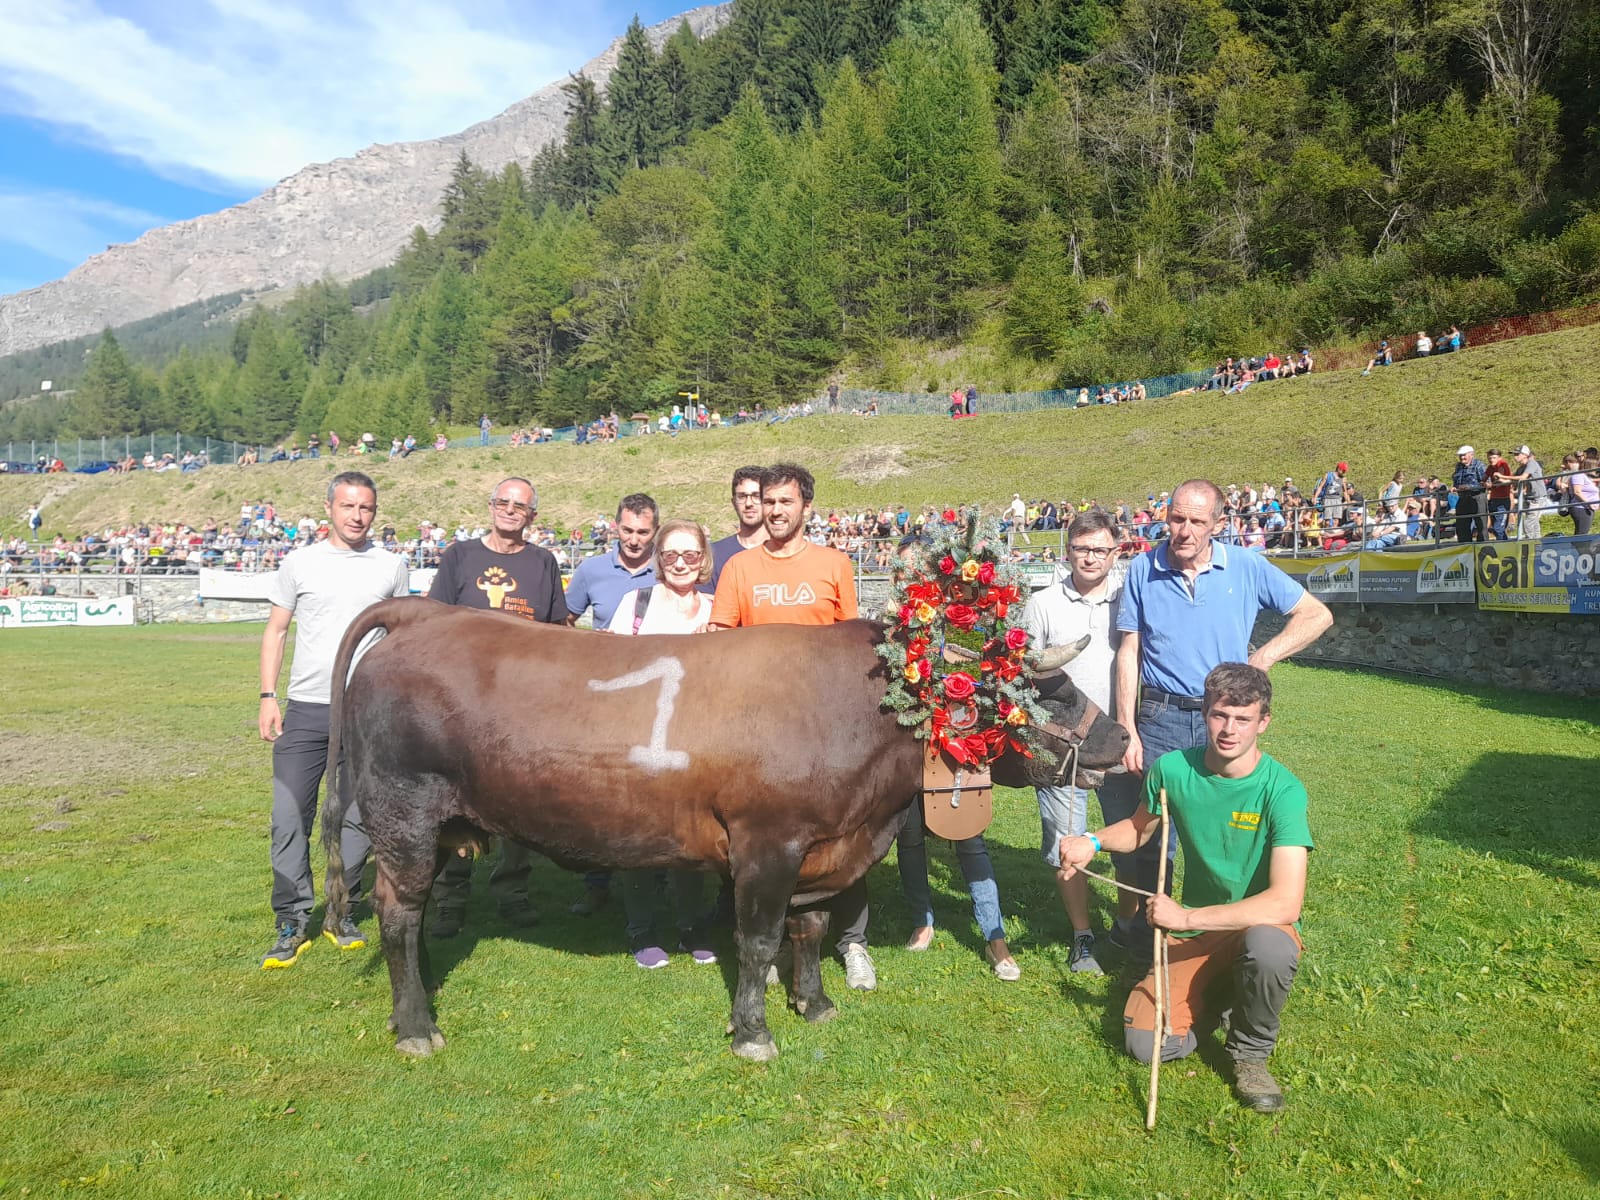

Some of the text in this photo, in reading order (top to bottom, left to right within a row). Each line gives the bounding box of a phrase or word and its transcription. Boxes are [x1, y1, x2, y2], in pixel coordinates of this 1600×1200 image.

[1478, 544, 1529, 589] Gal
[752, 581, 816, 607] FILA
[50, 611, 75, 620] ALPI
[586, 655, 690, 772] 1
